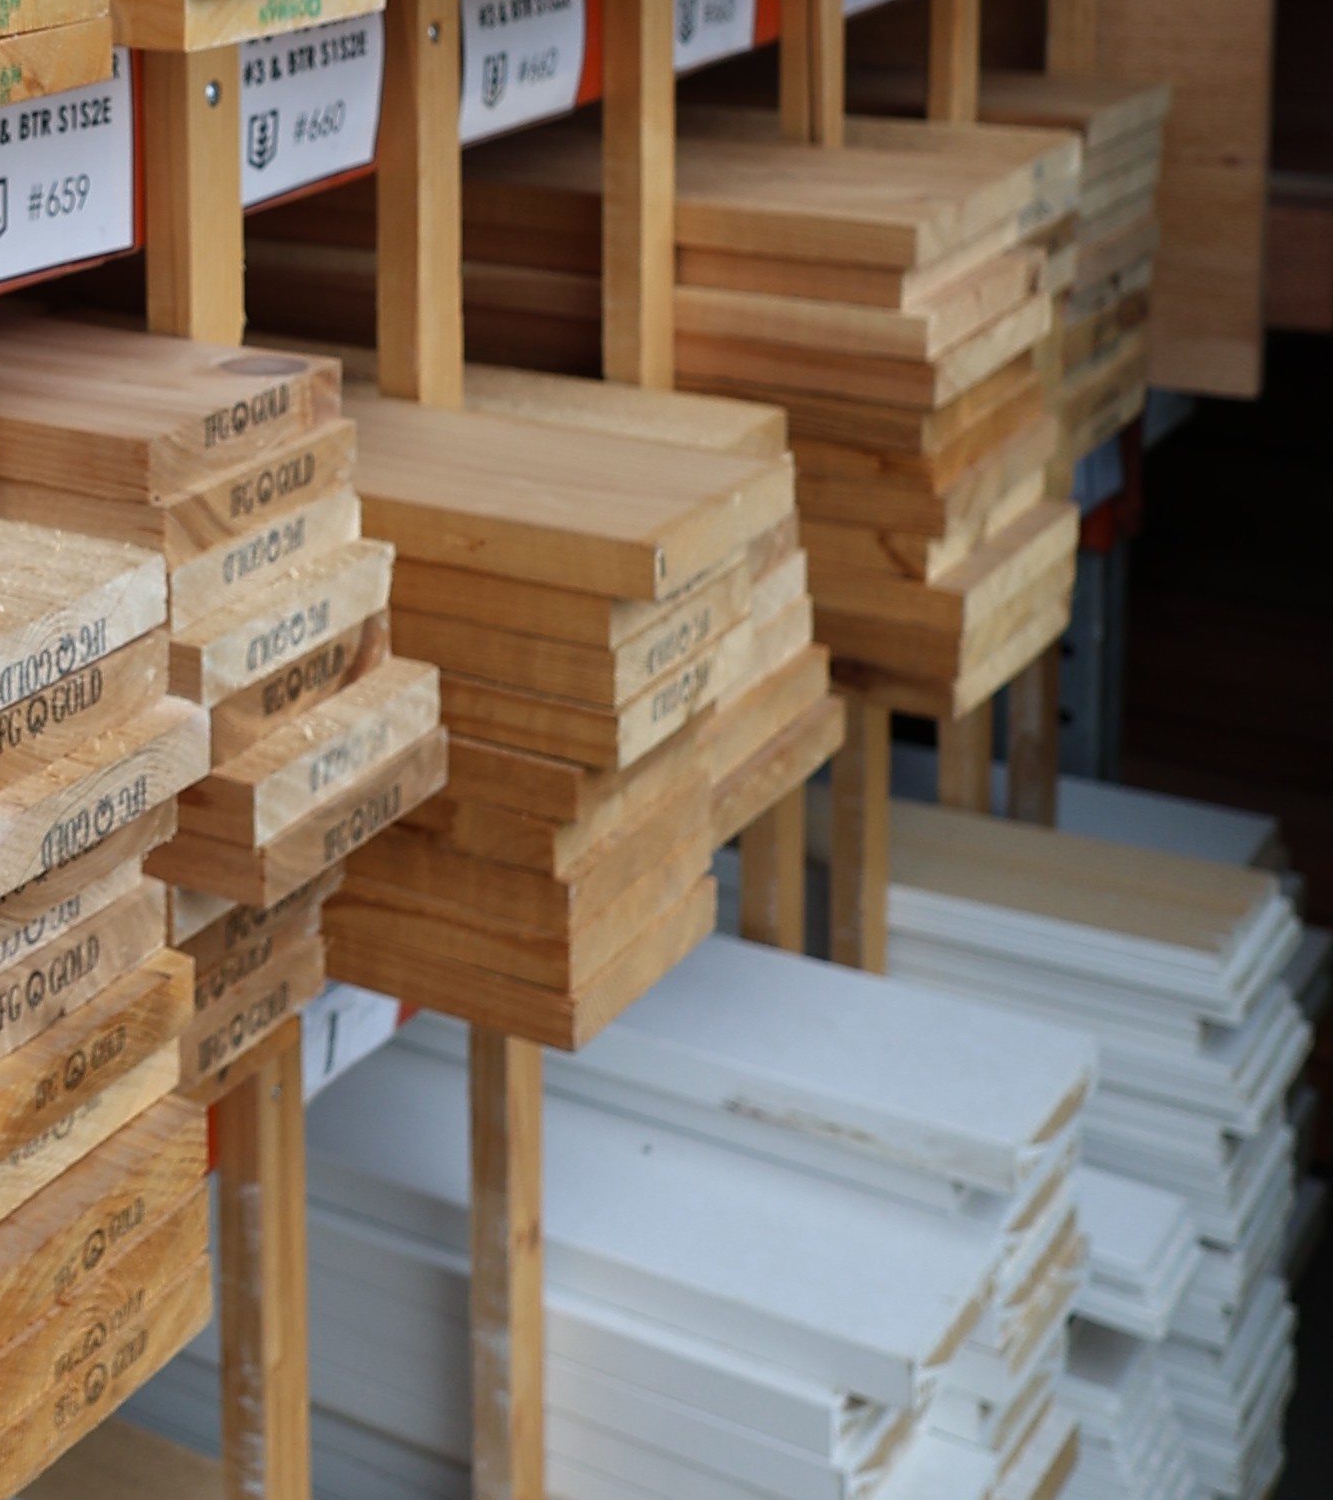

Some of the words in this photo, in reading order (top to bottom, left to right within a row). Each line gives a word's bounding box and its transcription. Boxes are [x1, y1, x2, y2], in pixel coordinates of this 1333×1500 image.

[244, 58, 265, 87] #3
[288, 45, 315, 76] BTR
[0, 118, 11, 146] &
[19, 108, 51, 140] BTR
[57, 97, 112, 133] S1S2E
[28, 173, 91, 220] #659
[51, 668, 104, 723] GOLD
[49, 934, 100, 992] GOLD
